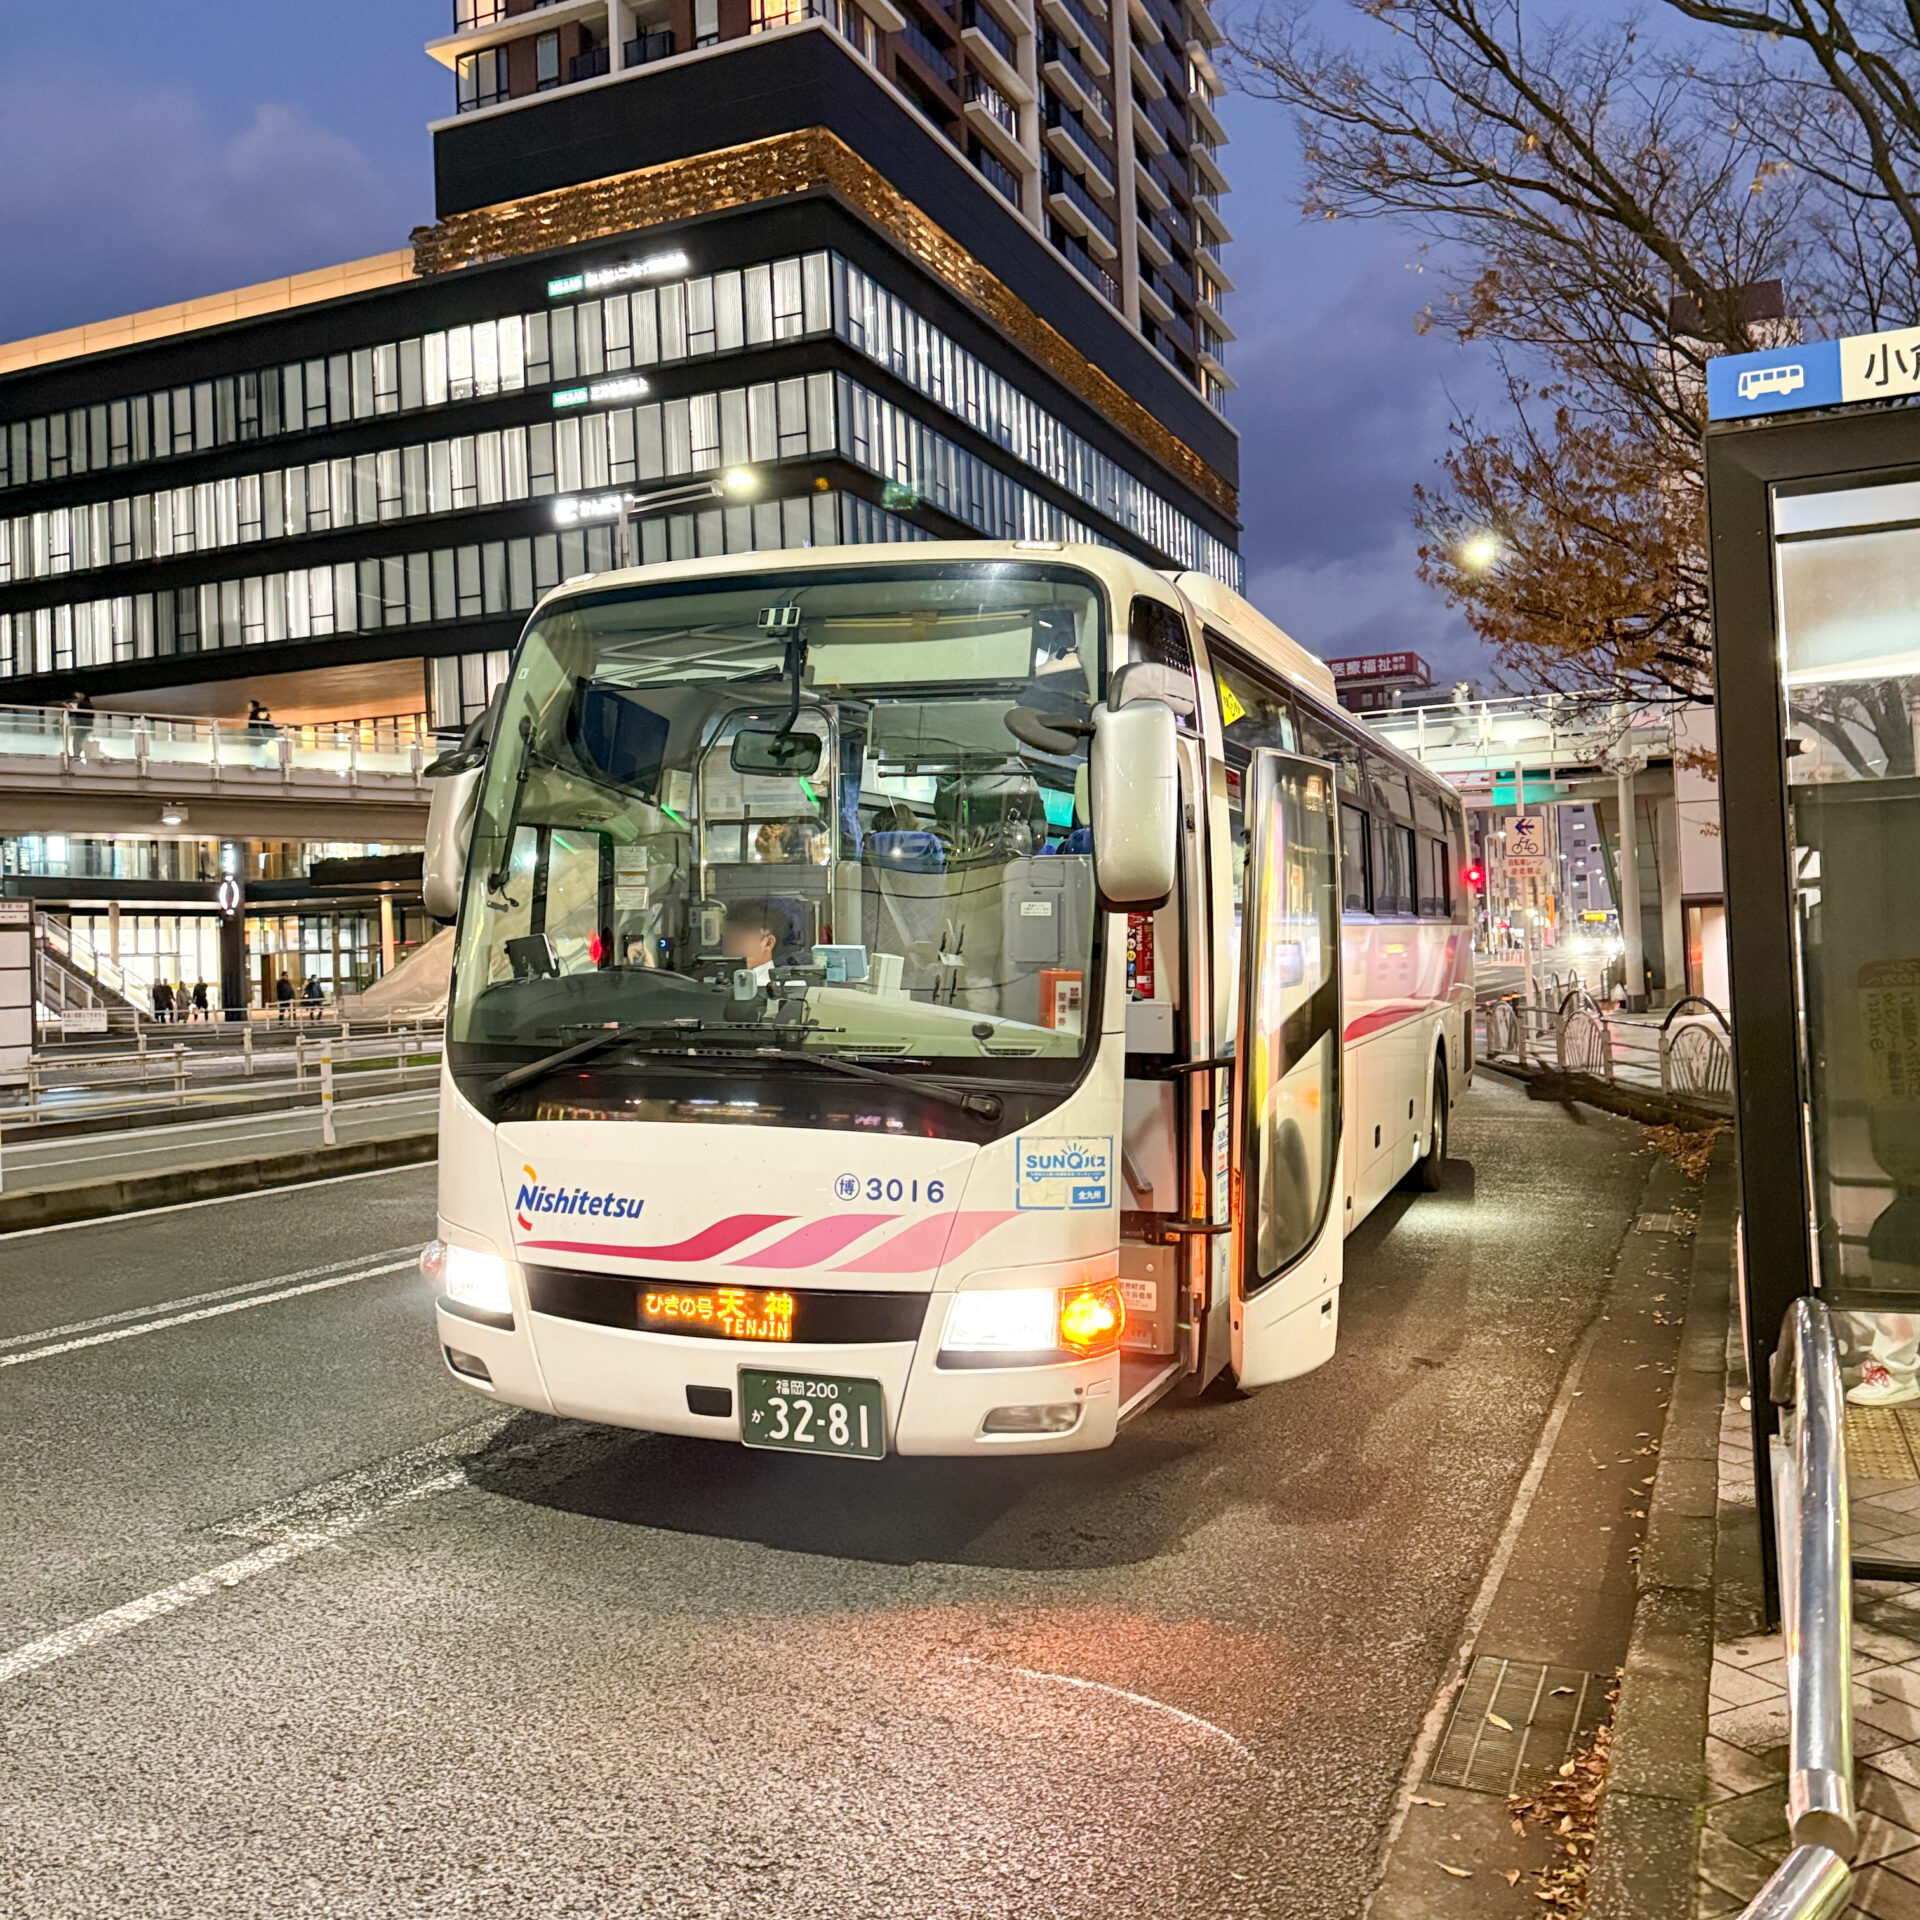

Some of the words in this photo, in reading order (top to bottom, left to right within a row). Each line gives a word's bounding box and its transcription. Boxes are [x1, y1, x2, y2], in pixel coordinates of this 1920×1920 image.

[1865, 343, 1920, 387] 小
[515, 1184, 645, 1219] Nishitetsu
[866, 1178, 944, 1203] 3016
[1078, 1190, 1102, 1200] 全九州
[646, 1293, 714, 1319] ひきの号
[717, 1289, 793, 1322] 天神
[722, 1317, 788, 1339] TENJIN
[751, 1409, 765, 1424] か
[768, 1397, 869, 1449] 32-81
